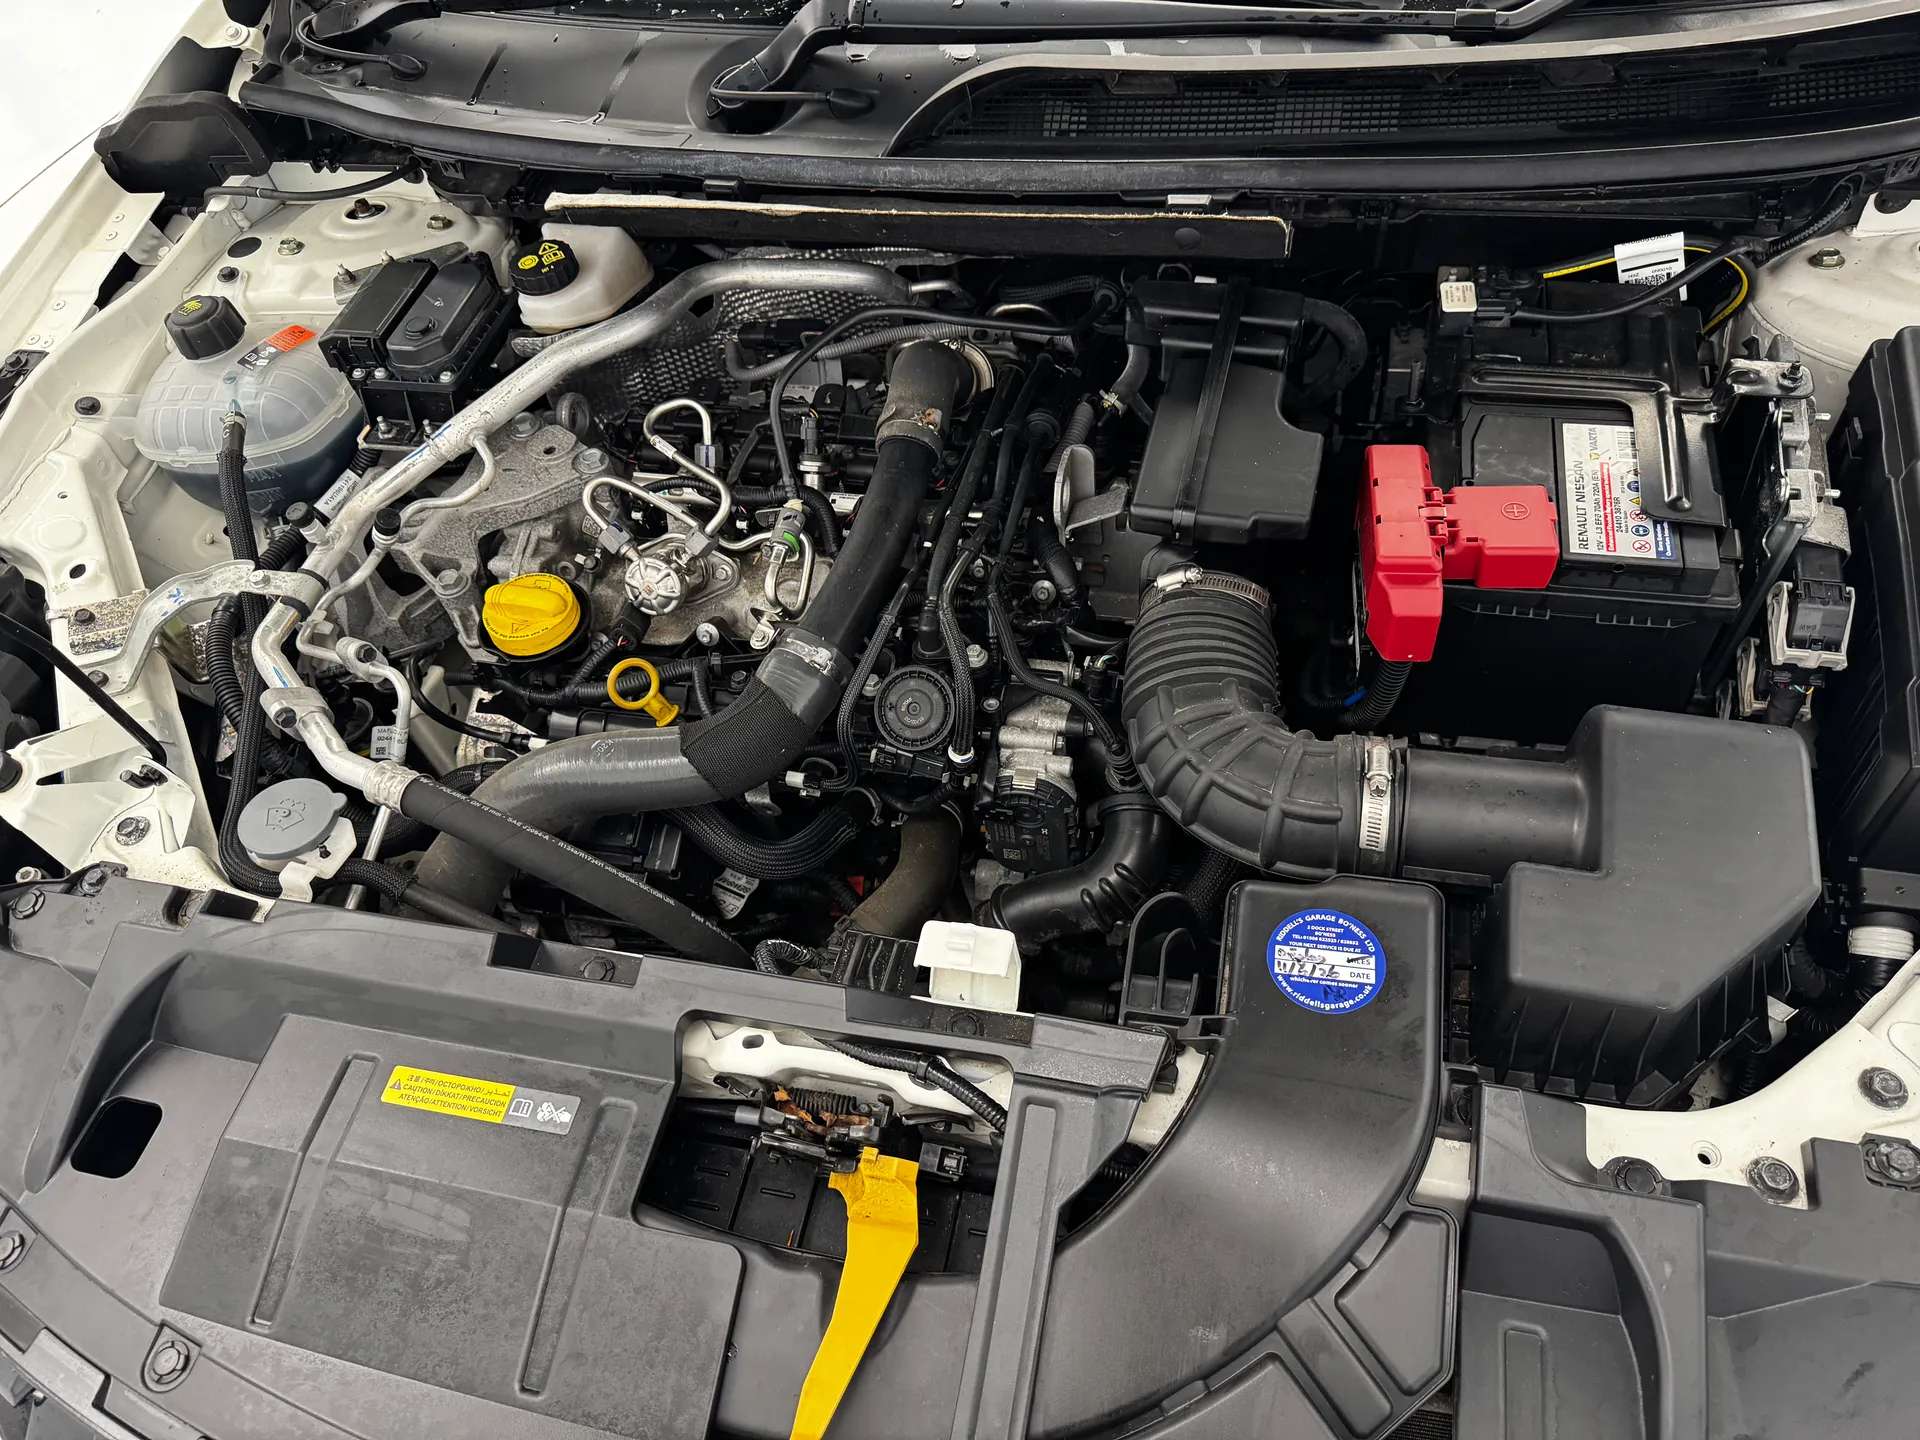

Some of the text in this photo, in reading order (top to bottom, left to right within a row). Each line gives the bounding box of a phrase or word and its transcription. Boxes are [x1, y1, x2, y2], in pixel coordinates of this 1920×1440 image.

[1588, 427, 1598, 452] VARTA
[1573, 460, 1588, 550] RENAULT NISSAN
[1276, 914, 1375, 952] RIDDELL'S GARAGE BO'NESS LTD
[1290, 976, 1318, 984] whichever
[1350, 971, 1371, 979] DATE
[1277, 974, 1373, 1010] www.riddellsgarage.co.uk
